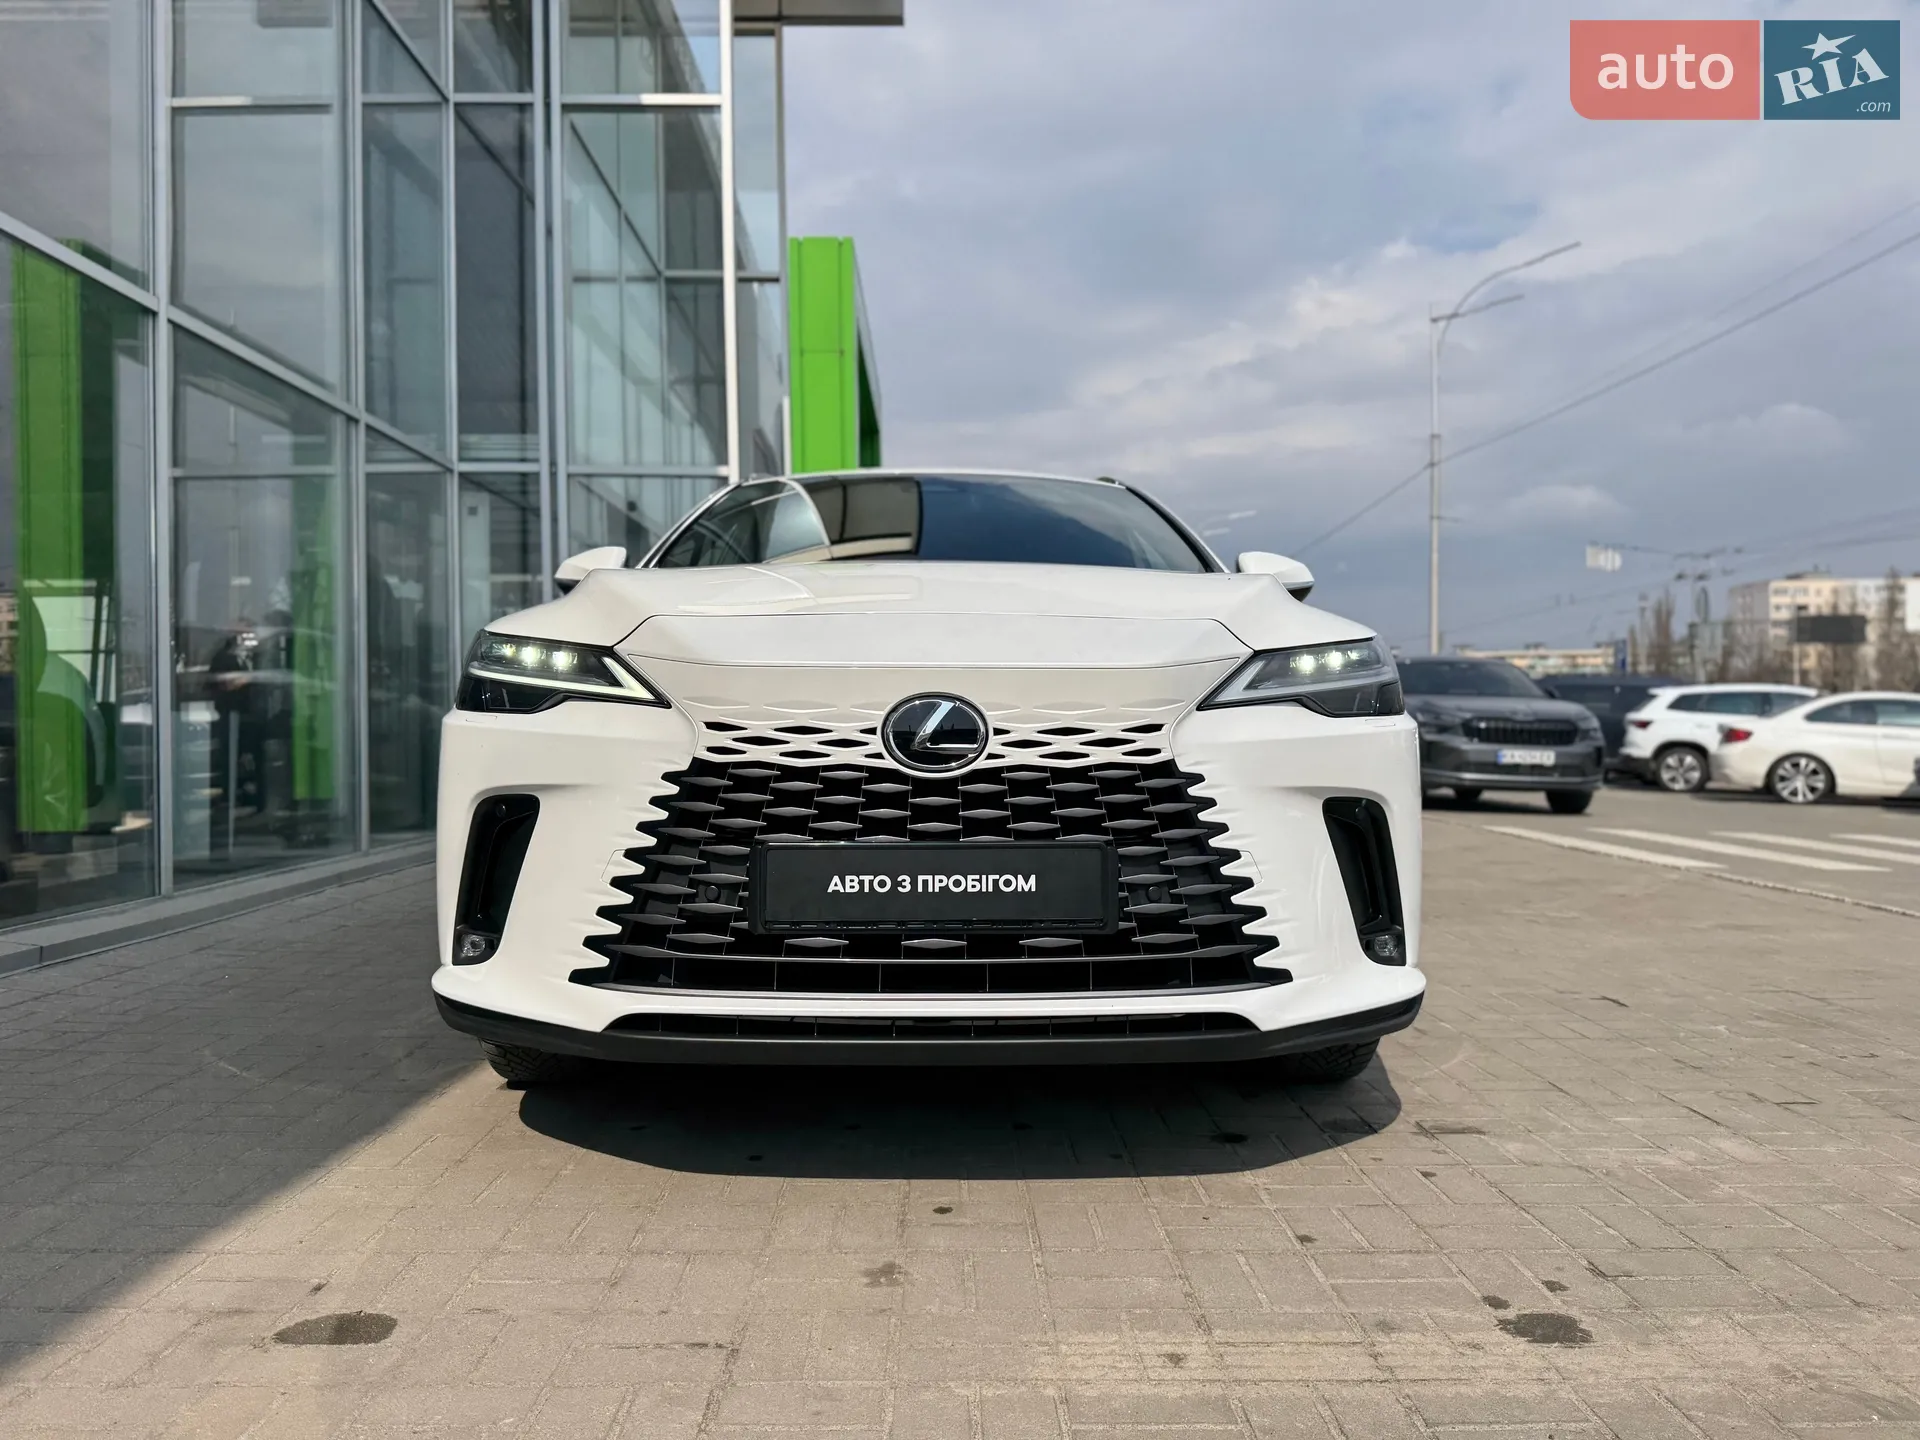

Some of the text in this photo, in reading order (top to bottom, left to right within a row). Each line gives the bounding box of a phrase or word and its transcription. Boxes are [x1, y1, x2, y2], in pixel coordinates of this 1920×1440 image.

[827, 874, 1036, 893] АВТО З ПРОБІГОМ
